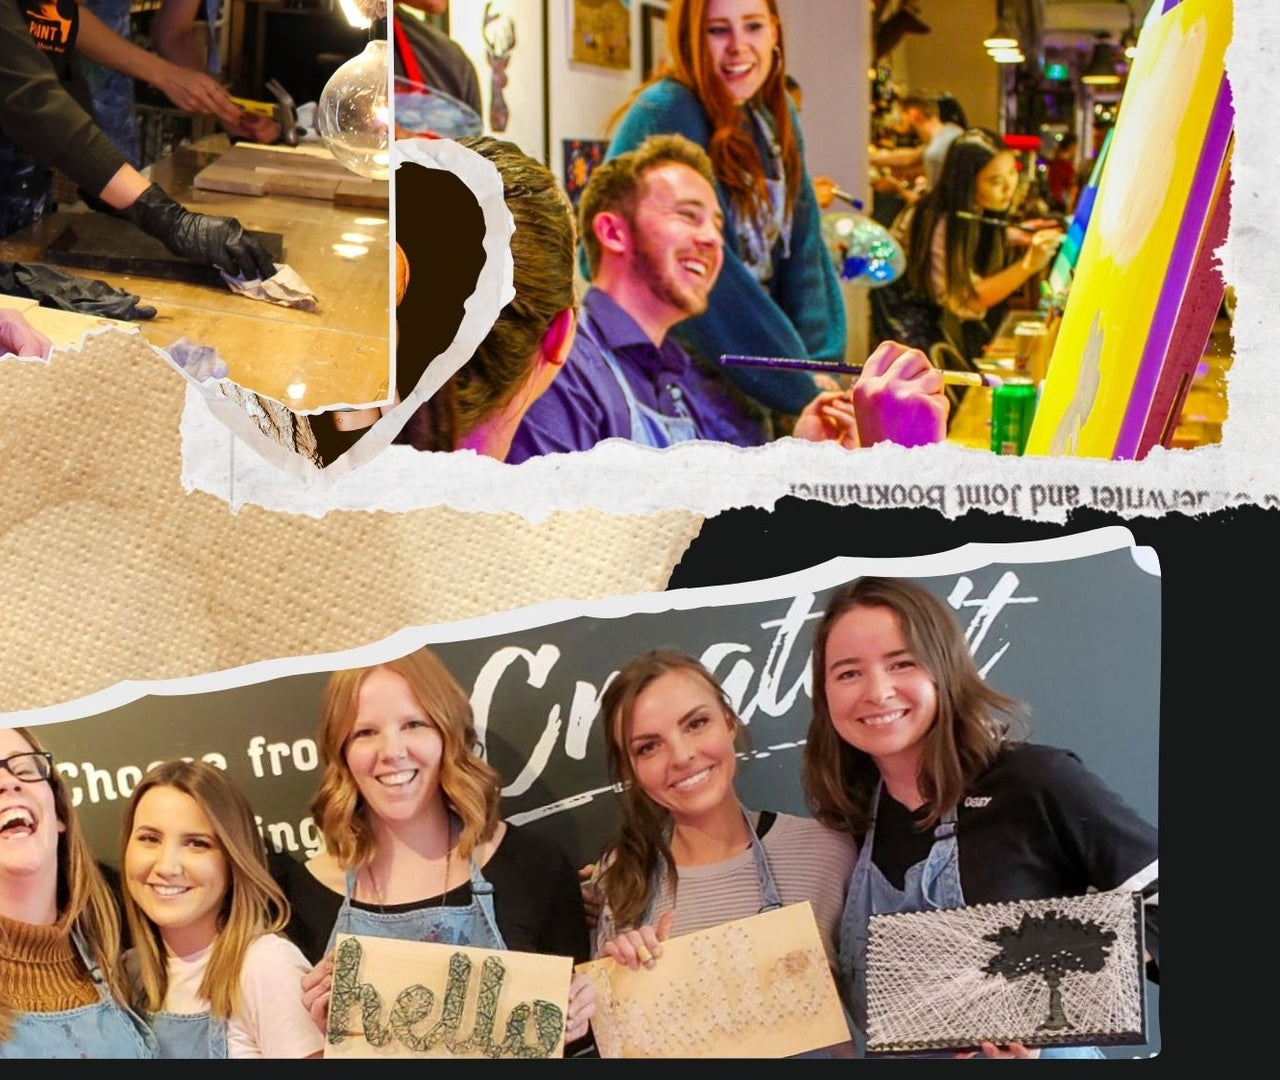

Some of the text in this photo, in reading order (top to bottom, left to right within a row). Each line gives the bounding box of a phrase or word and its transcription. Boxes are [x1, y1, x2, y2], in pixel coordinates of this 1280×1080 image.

[1030, 484, 1080, 515] and
[248, 735, 320, 778] fro
[256, 815, 325, 857] ing
[328, 936, 563, 1059] hello
